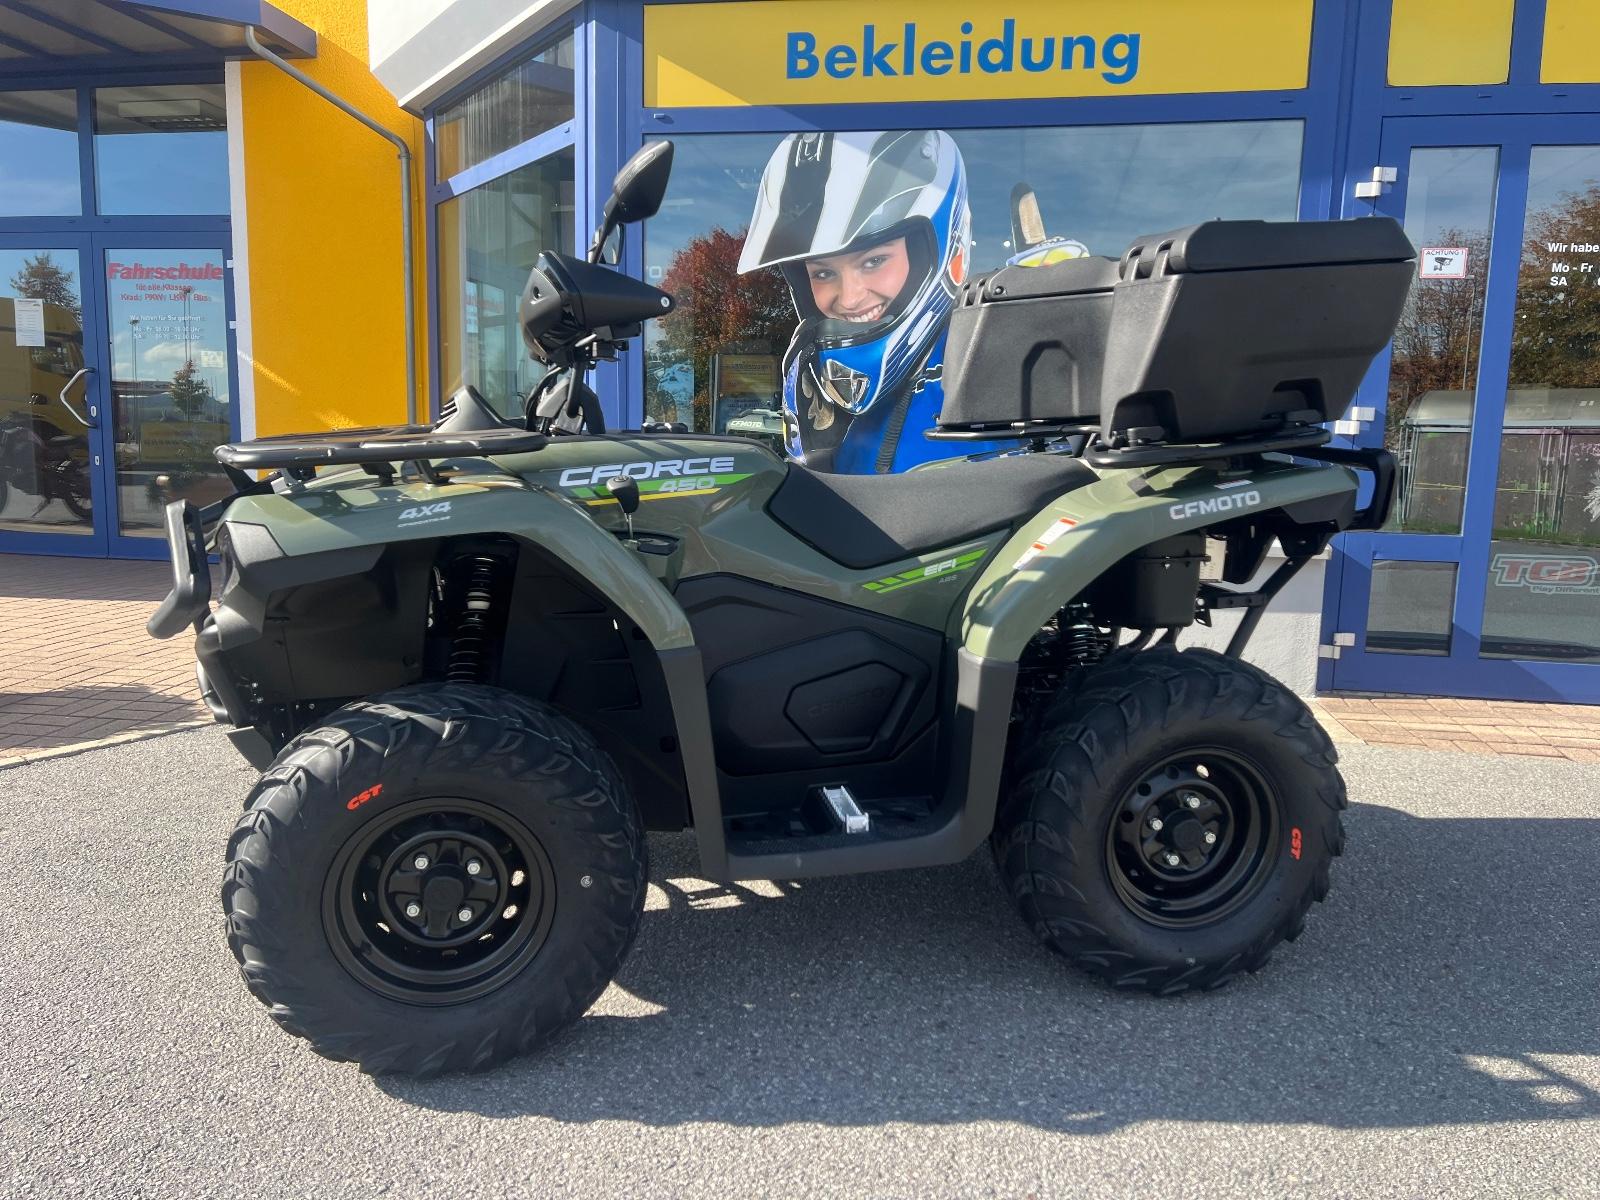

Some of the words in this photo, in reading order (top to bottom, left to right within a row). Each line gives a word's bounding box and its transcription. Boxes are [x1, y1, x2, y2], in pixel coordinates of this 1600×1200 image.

[786, 18, 1141, 85] Bekleidung
[1548, 242, 1568, 253] Wir
[107, 262, 224, 280] Fahrschule
[1551, 262, 1570, 273] Mo
[1580, 262, 1594, 273] Fr
[1550, 276, 1568, 286] SA
[558, 456, 735, 487] CFORCE
[657, 477, 716, 493] 450
[1169, 490, 1261, 520] CFMOTO
[924, 558, 957, 577] EFI
[346, 783, 383, 811] CST
[1291, 827, 1302, 860] CST
